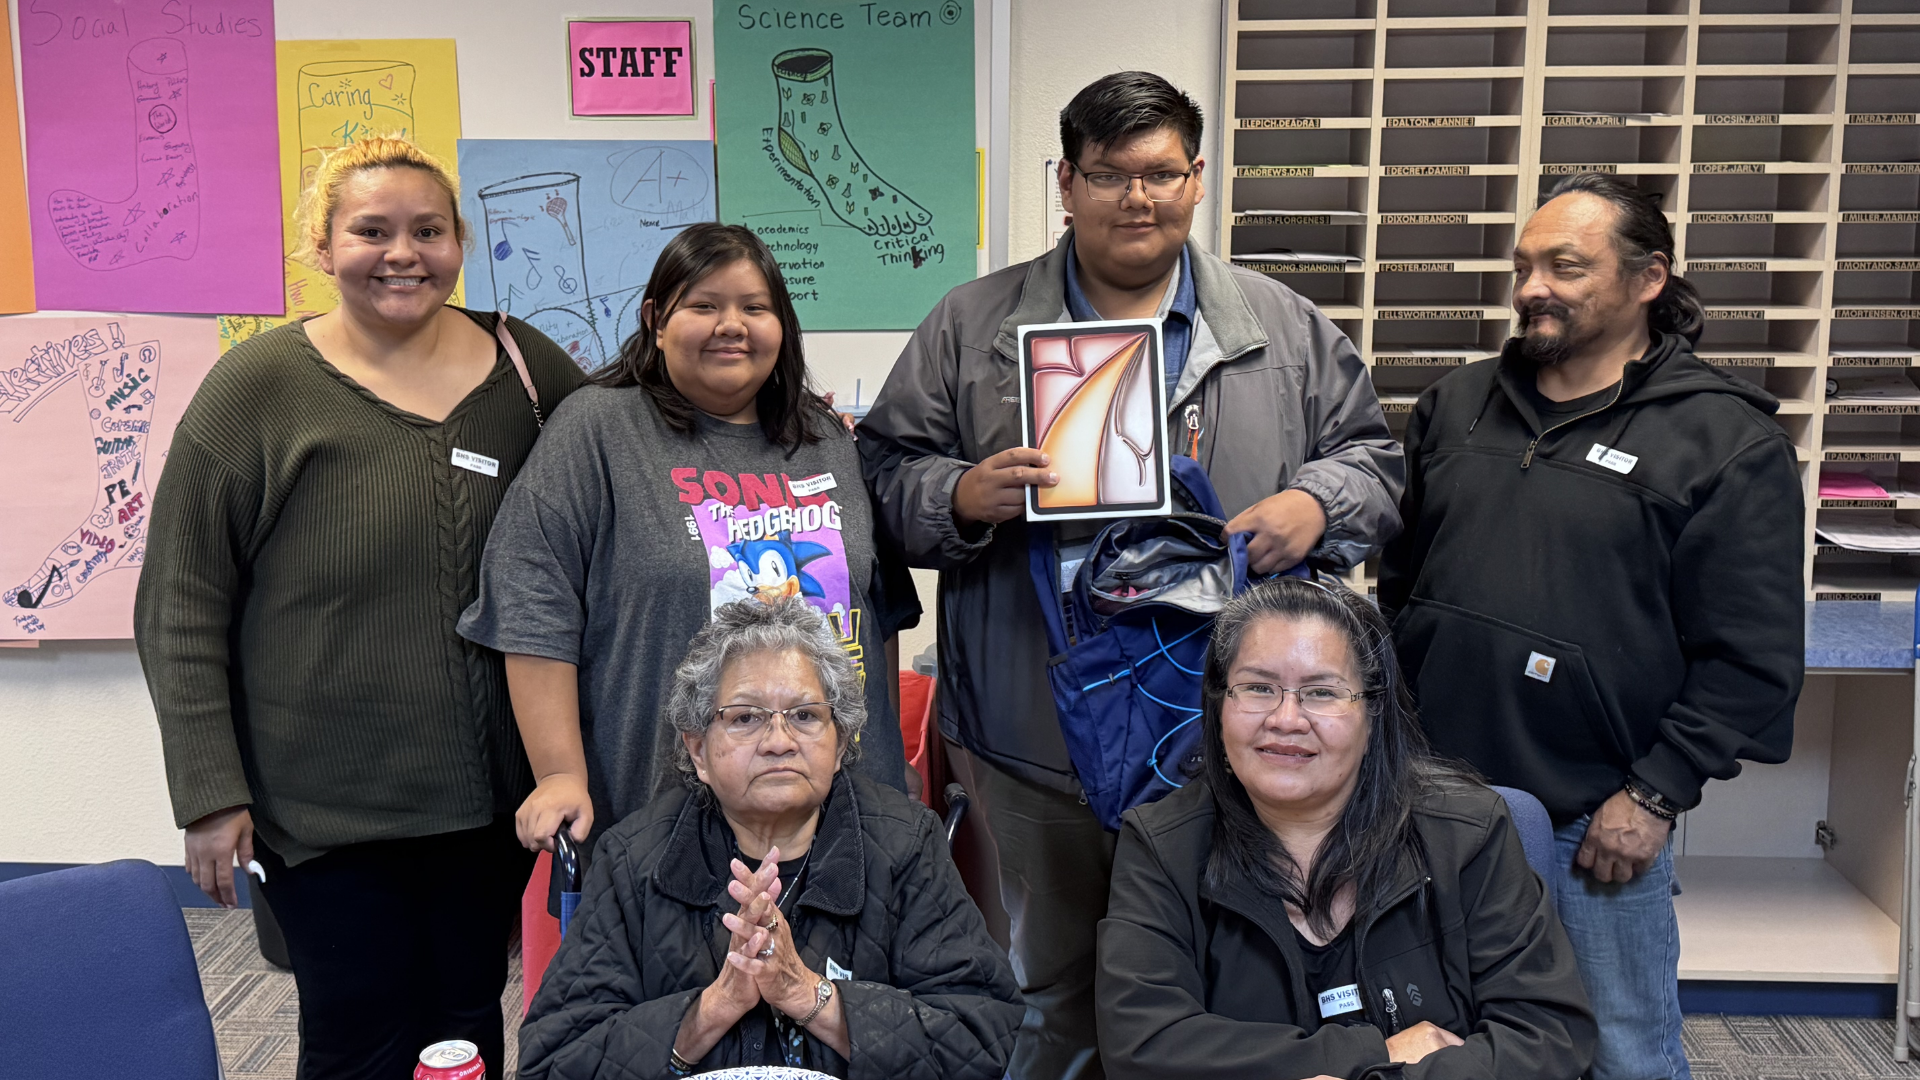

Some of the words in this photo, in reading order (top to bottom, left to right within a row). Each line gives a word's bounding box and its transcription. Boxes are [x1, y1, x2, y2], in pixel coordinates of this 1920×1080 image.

[30, 0, 129, 46] Social
[162, 0, 262, 38] Studies
[738, 4, 845, 29] Science
[860, 2, 932, 28] Team
[579, 47, 683, 77] STAFF
[308, 83, 373, 120] Caring
[762, 127, 821, 208] Experimentation
[136, 192, 199, 253] Collaboration
[757, 224, 809, 235] academics
[874, 226, 935, 250] Critical
[877, 243, 945, 269] Thinking
[0, 322, 126, 412] lectives!
[471, 456, 497, 468] VISITOR
[104, 478, 132, 505] PE
[118, 492, 145, 525] ART
[728, 501, 842, 543] HEDGEHOG
[80, 527, 116, 553] VIDEO
[684, 514, 701, 541] 1991
[1339, 1001, 1355, 1009] PASS
